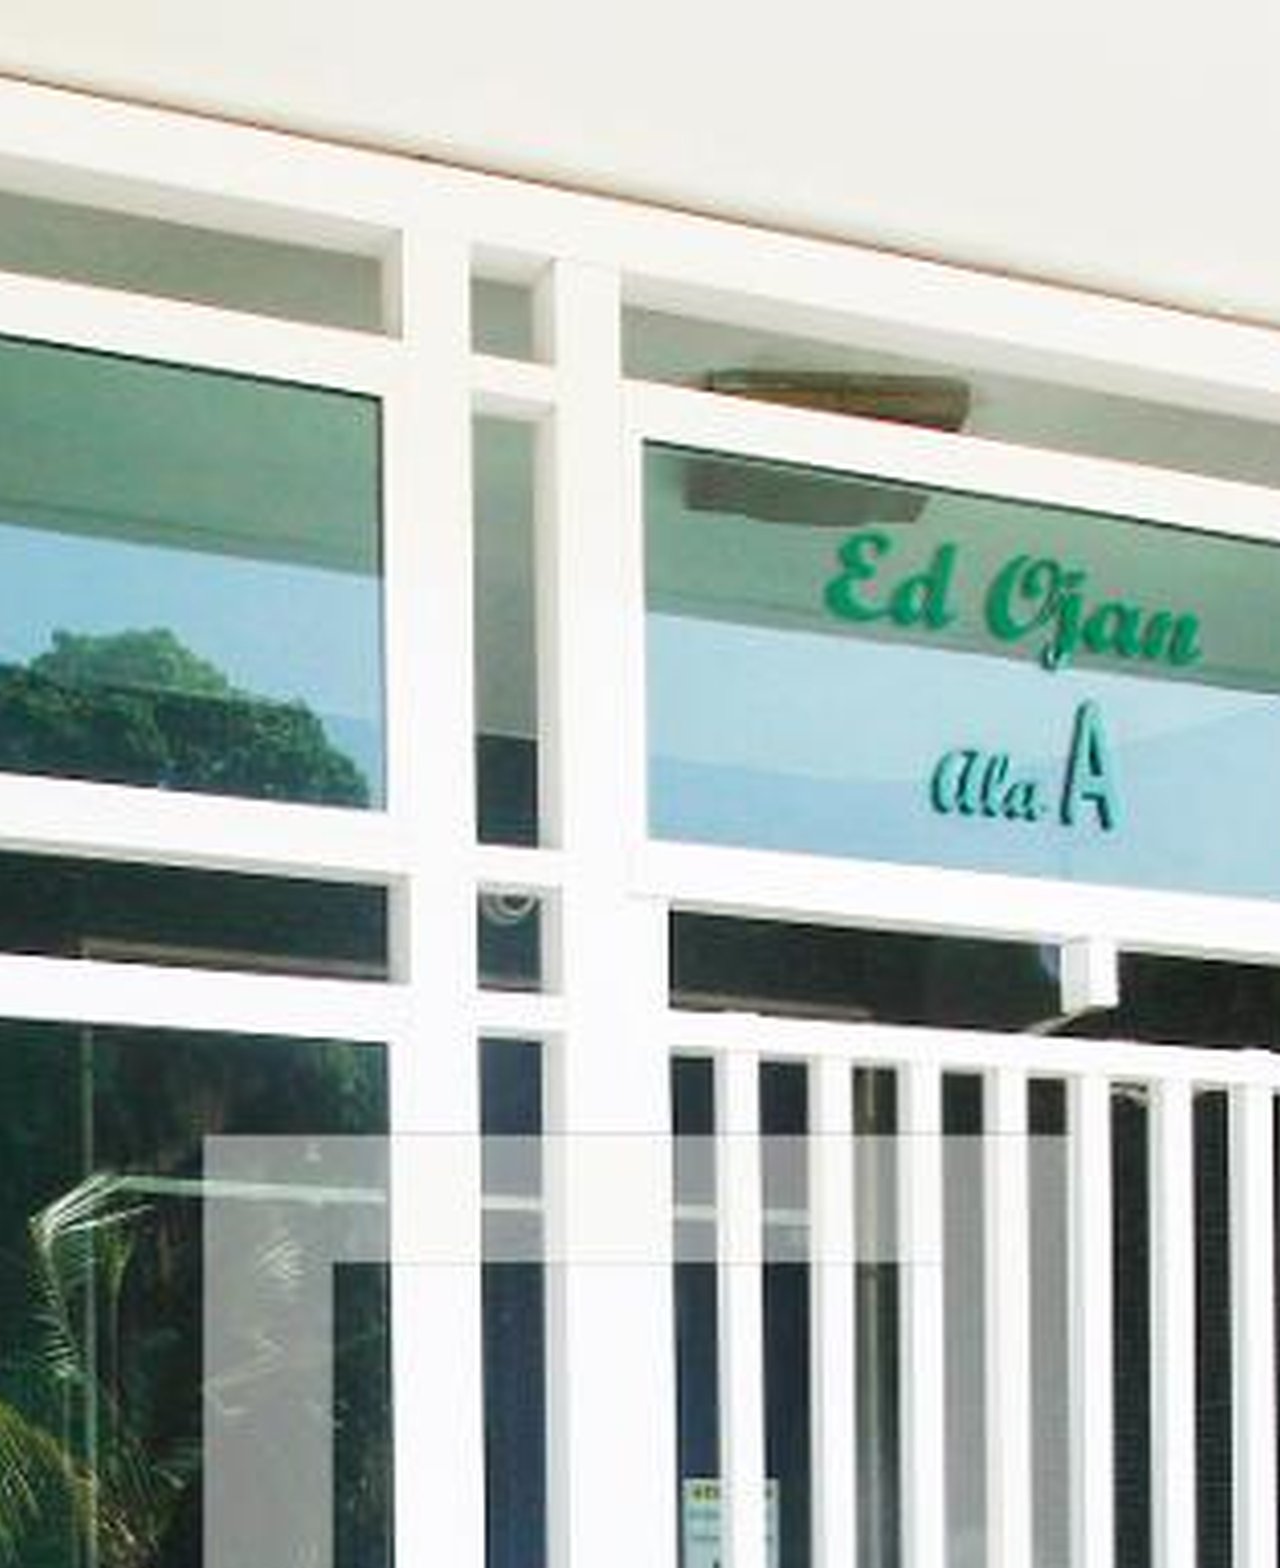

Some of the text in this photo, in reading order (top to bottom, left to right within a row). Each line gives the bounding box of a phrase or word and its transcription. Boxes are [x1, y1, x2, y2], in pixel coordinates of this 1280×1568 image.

[824, 532, 1202, 671] Ed Ojan
[1059, 699, 1113, 831] A
